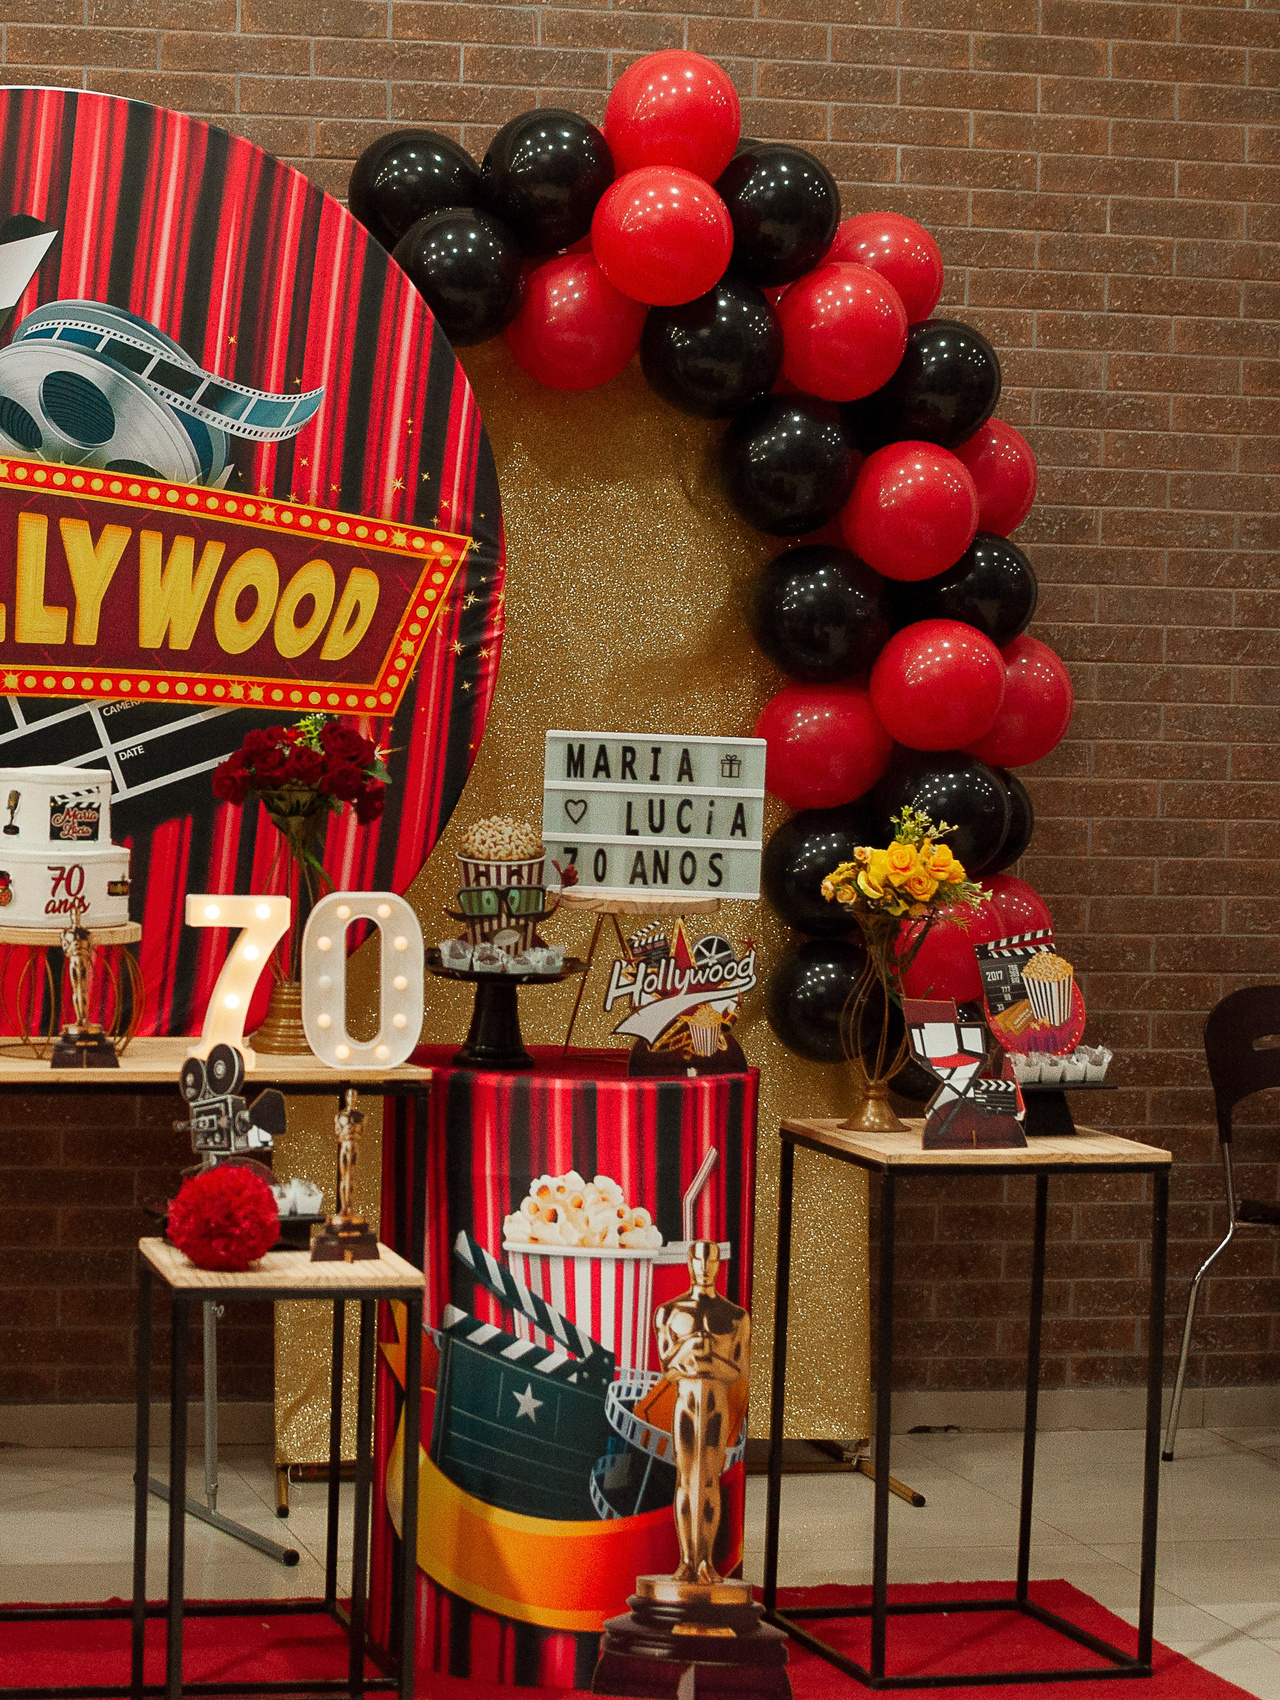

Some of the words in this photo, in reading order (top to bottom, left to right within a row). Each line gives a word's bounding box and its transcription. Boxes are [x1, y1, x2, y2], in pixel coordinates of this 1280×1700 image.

[119, 745, 144, 760] DATE
[566, 744, 694, 782] MARIA
[47, 864, 85, 897] 70
[628, 849, 723, 887] ANOS
[185, 891, 424, 1069] 70
[605, 950, 756, 1011] Hollywood
[986, 970, 1003, 982] 2017
